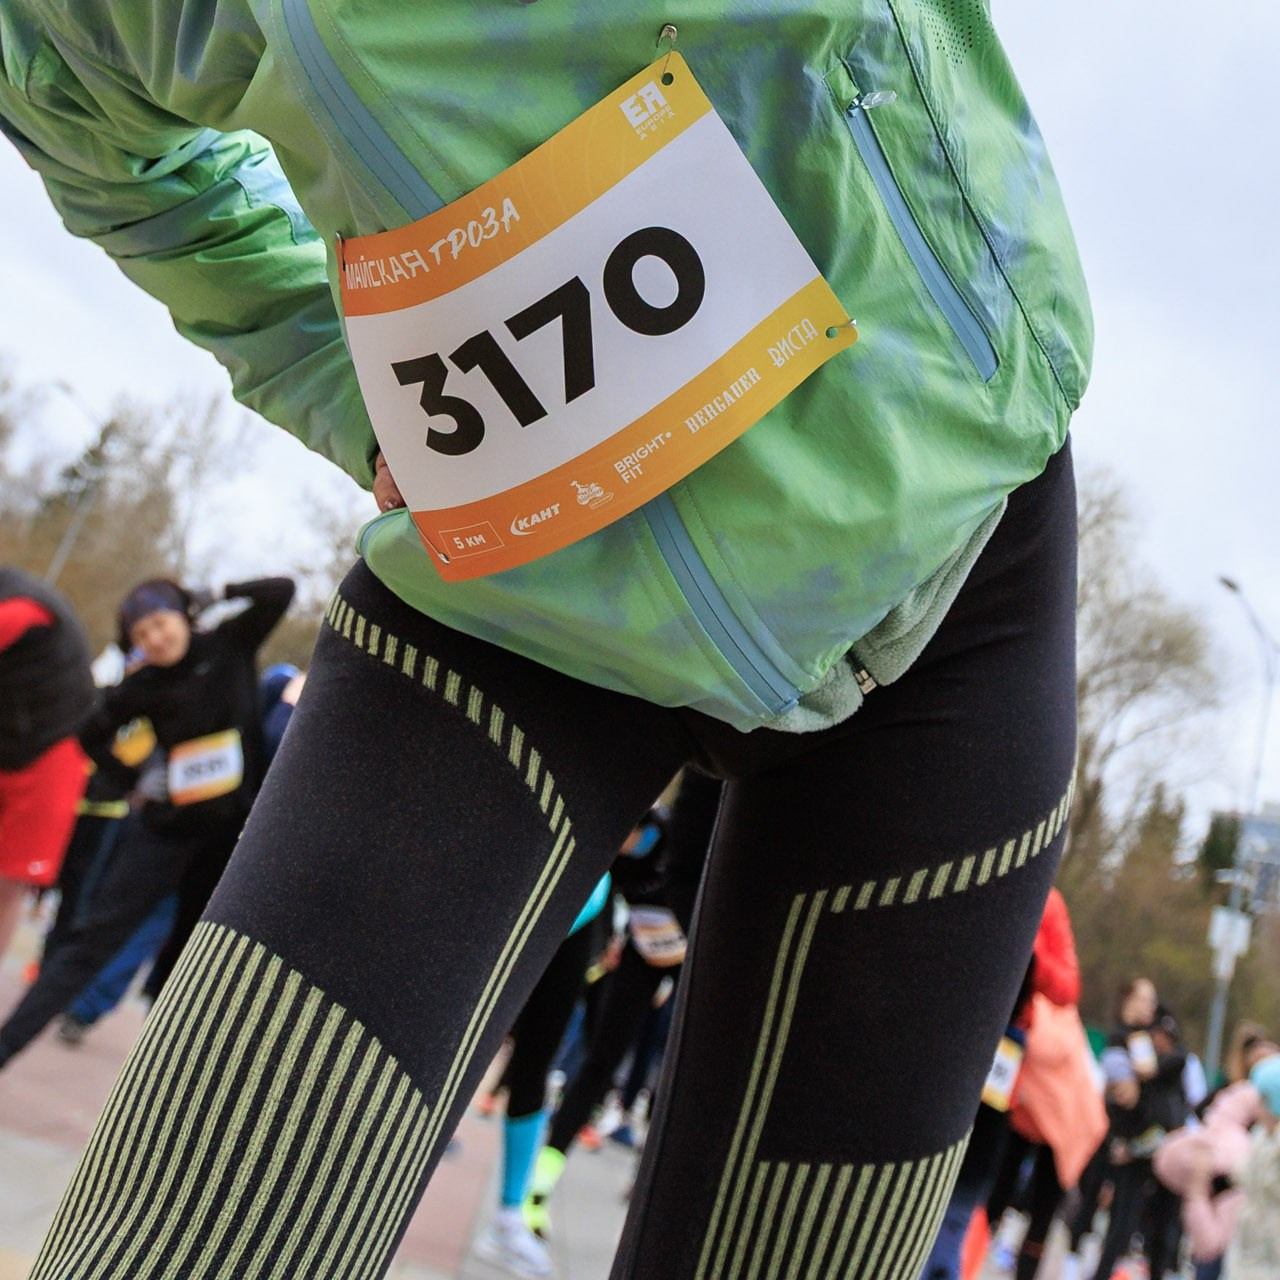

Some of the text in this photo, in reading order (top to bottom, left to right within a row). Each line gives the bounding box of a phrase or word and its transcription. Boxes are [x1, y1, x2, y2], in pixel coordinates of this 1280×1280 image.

[636, 105, 672, 135] EUROPE
[345, 198, 521, 289] МАЙСКАЯ ГРОЗА
[391, 226, 705, 456] 3170
[684, 367, 762, 434] BERGAUER
[621, 463, 645, 484] FIT
[517, 503, 561, 531] КАНТ
[453, 536, 466, 550] 5
